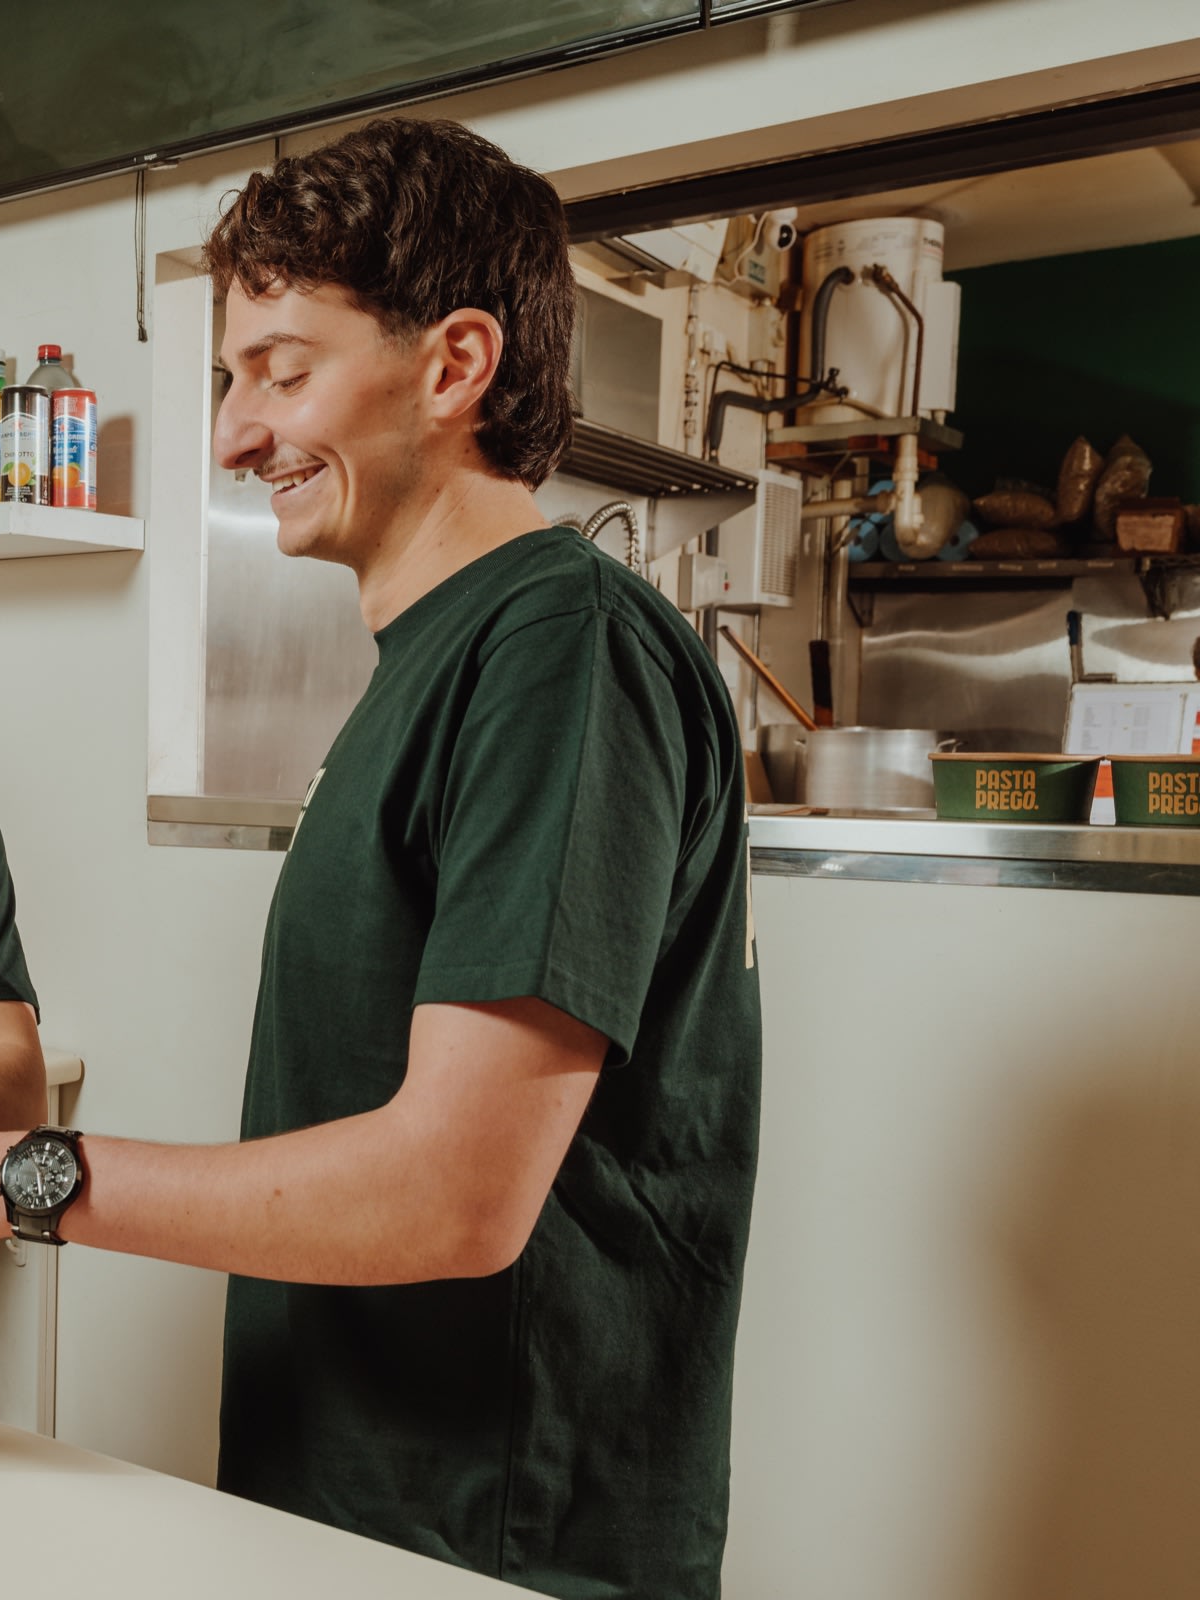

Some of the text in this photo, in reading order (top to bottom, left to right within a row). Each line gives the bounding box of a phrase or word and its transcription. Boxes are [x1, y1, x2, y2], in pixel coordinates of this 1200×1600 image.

[975, 769, 1036, 790] PASTA
[1148, 771, 1200, 793] PAST
[975, 789, 1039, 810] PREGO.
[1148, 793, 1200, 815] PREG
